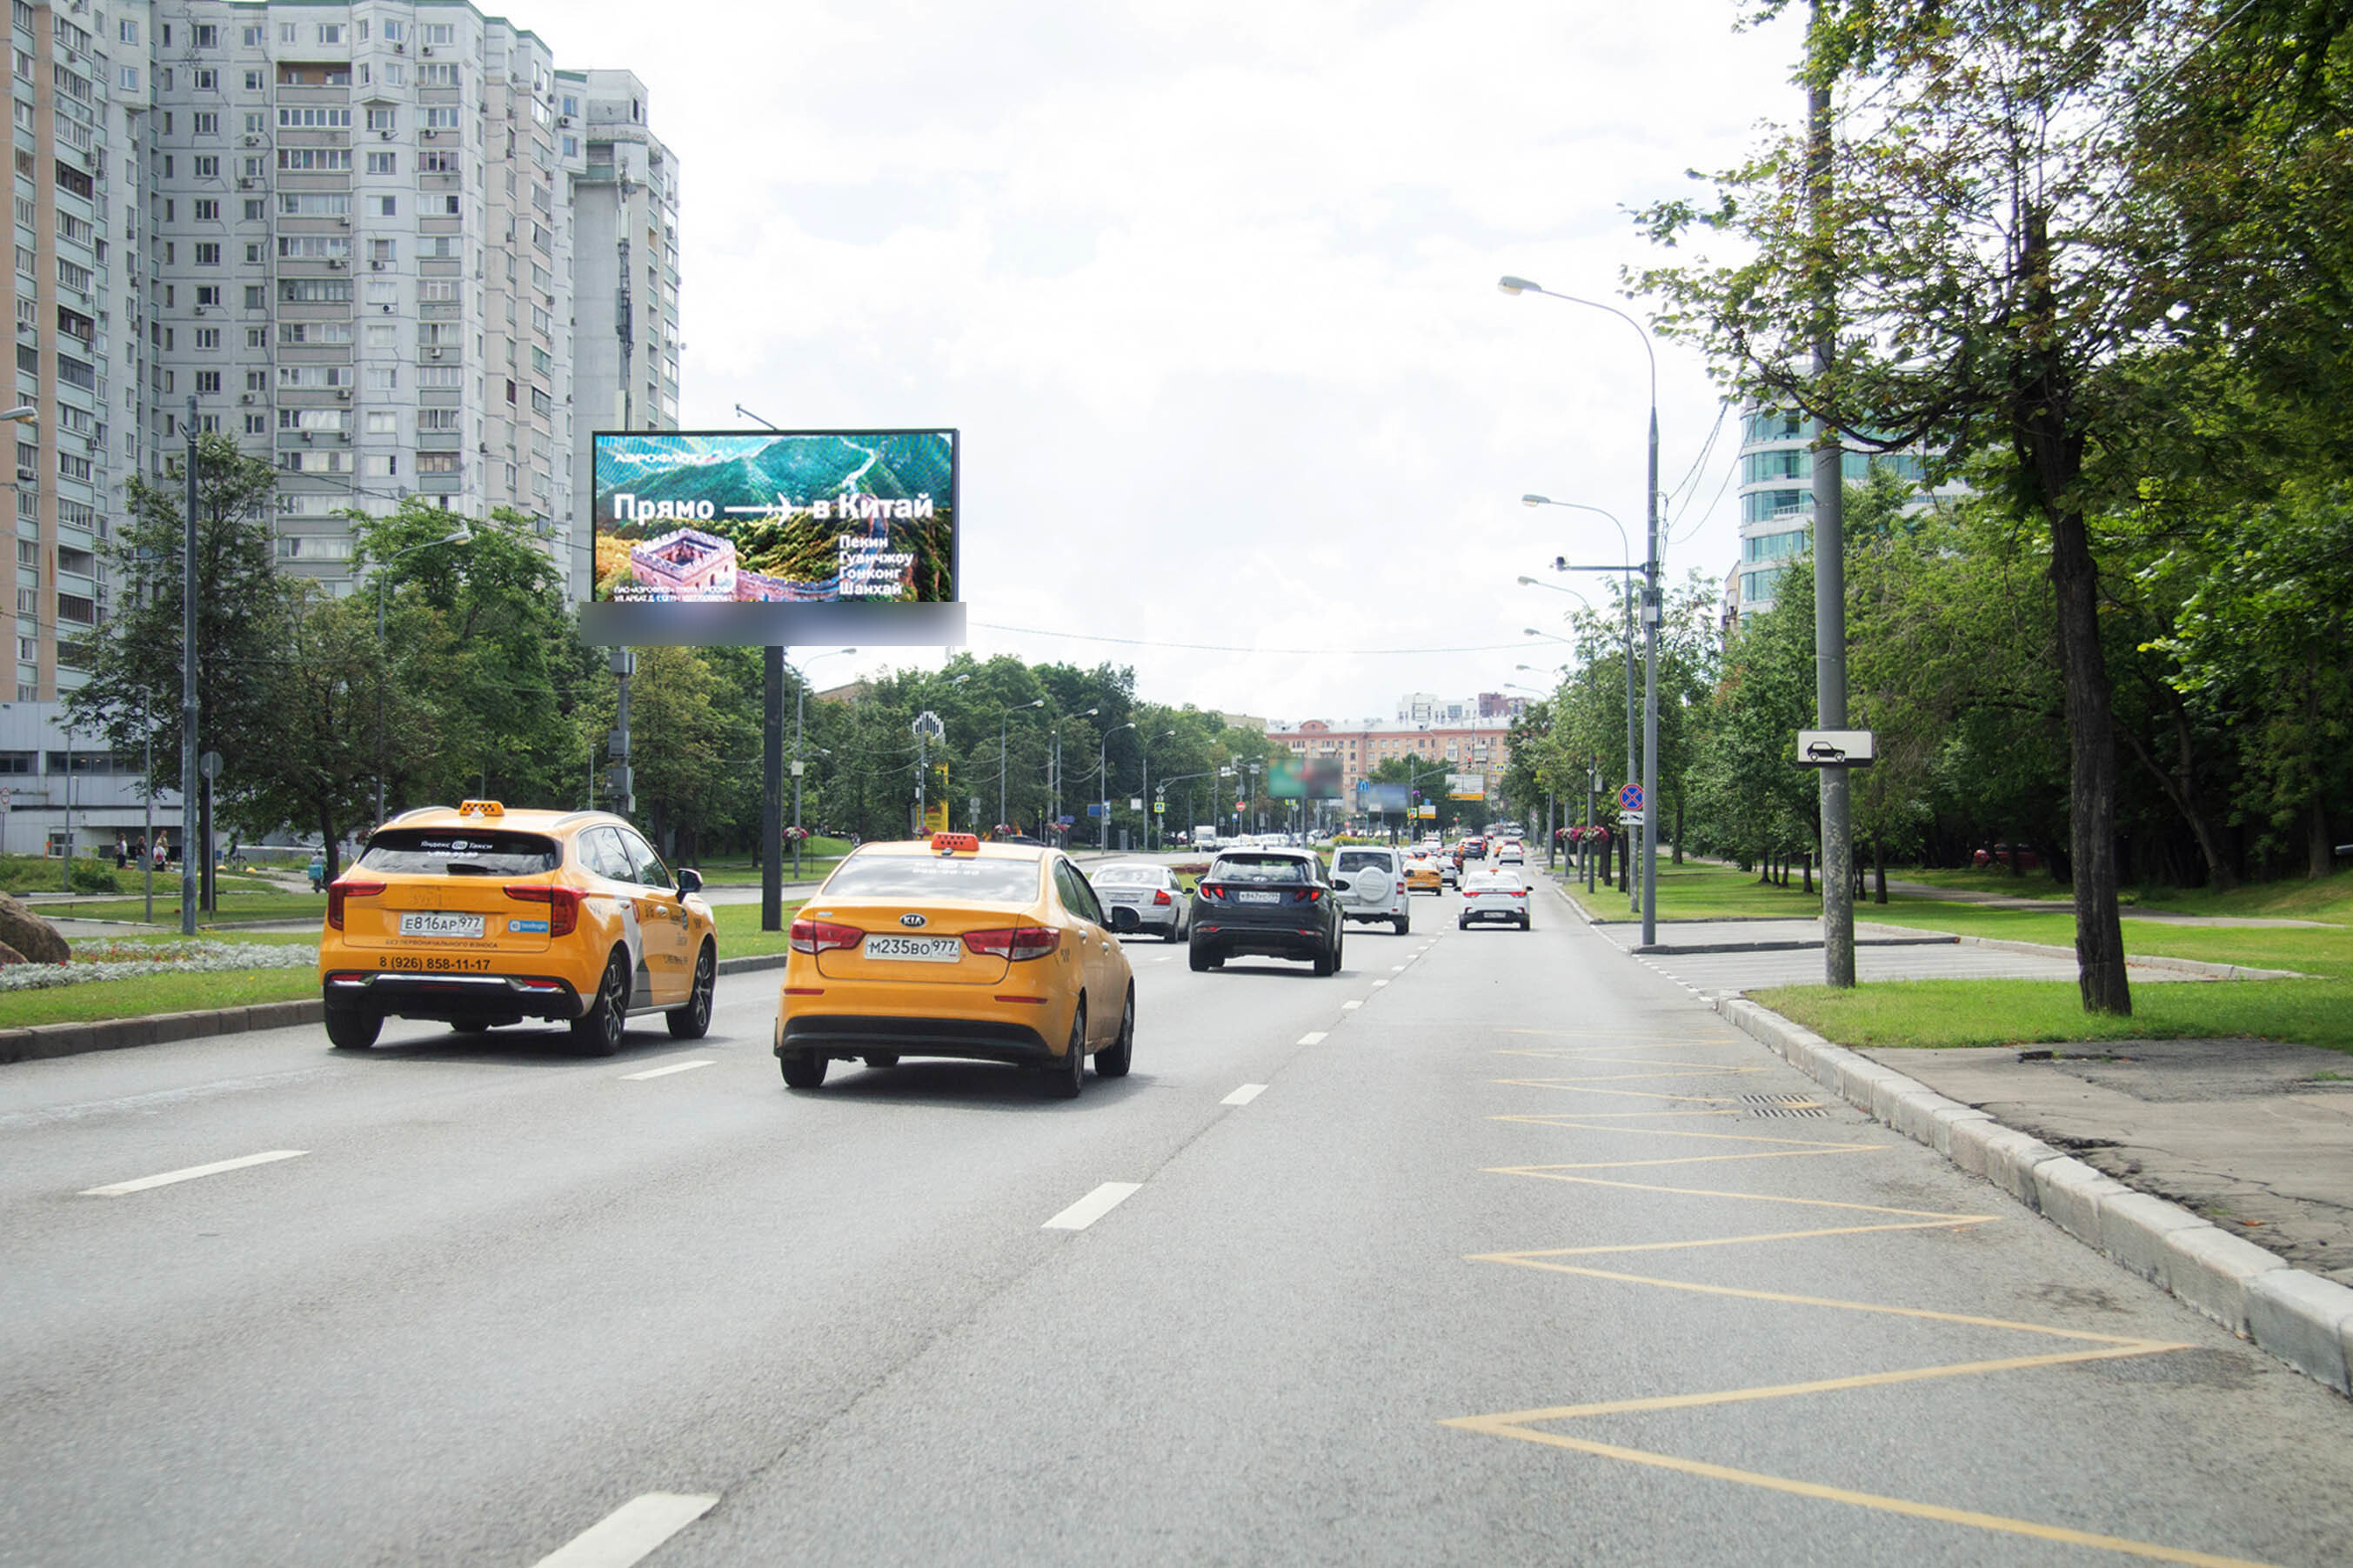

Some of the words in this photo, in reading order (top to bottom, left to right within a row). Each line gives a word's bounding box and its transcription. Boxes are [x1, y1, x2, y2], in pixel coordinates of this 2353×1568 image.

[614, 493, 715, 526] Прямо
[813, 500, 830, 519] в
[839, 492, 933, 519] Китай
[839, 535, 888, 548] Пекин
[839, 551, 913, 567] Гуанчжоу
[839, 566, 902, 579] Гонконг
[839, 582, 902, 595] Шанхай
[903, 916, 923, 925] KIA
[379, 957, 386, 967] 8
[391, 957, 423, 971] (926)
[426, 957, 491, 971] 858-11-17
